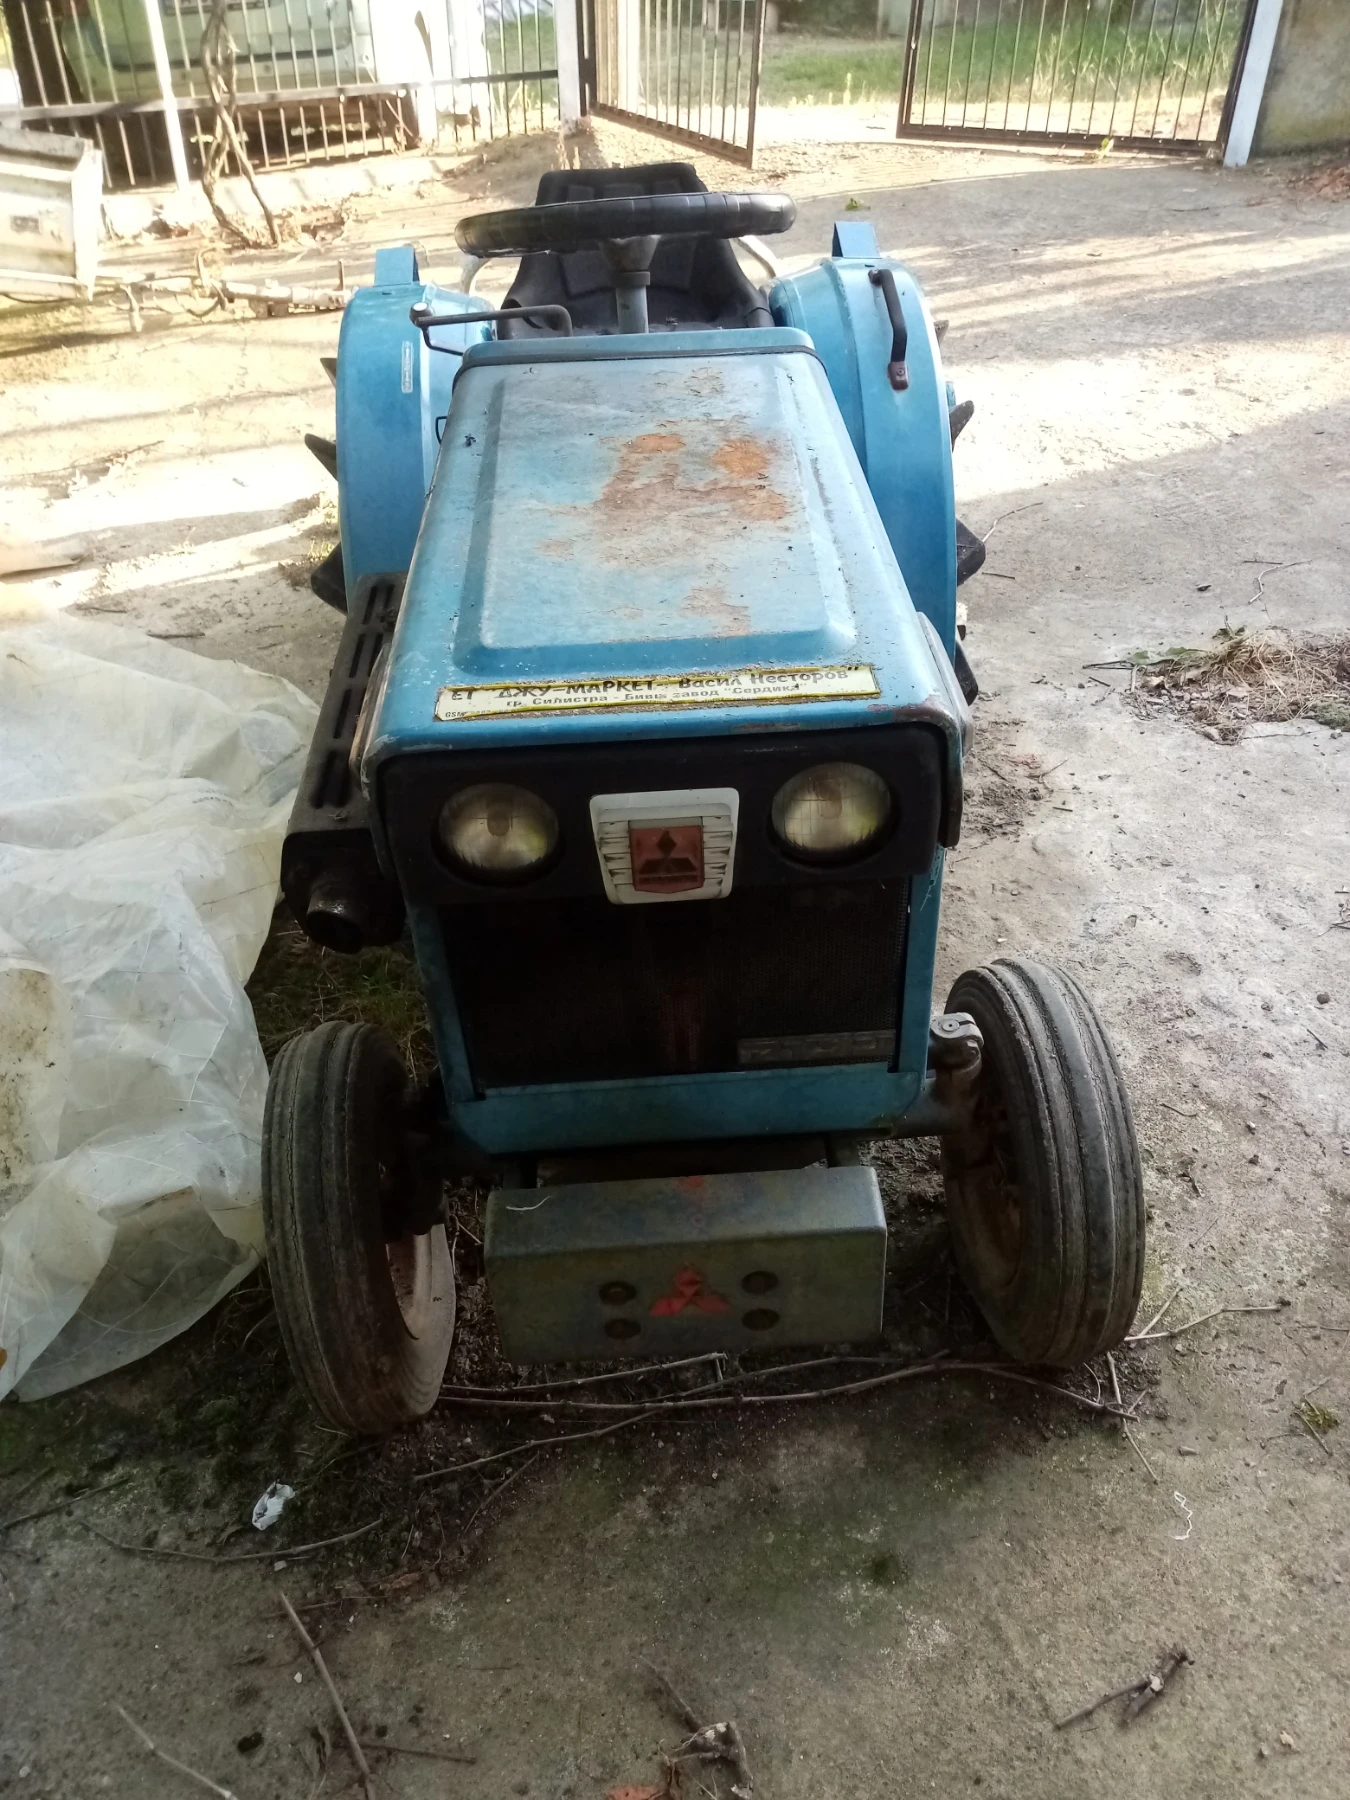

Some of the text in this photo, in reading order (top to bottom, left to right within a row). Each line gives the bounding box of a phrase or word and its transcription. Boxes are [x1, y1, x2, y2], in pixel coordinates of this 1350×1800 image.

[679, 677, 742, 689] Васил
[533, 696, 607, 705] Силистра
[673, 690, 719, 699] завод
